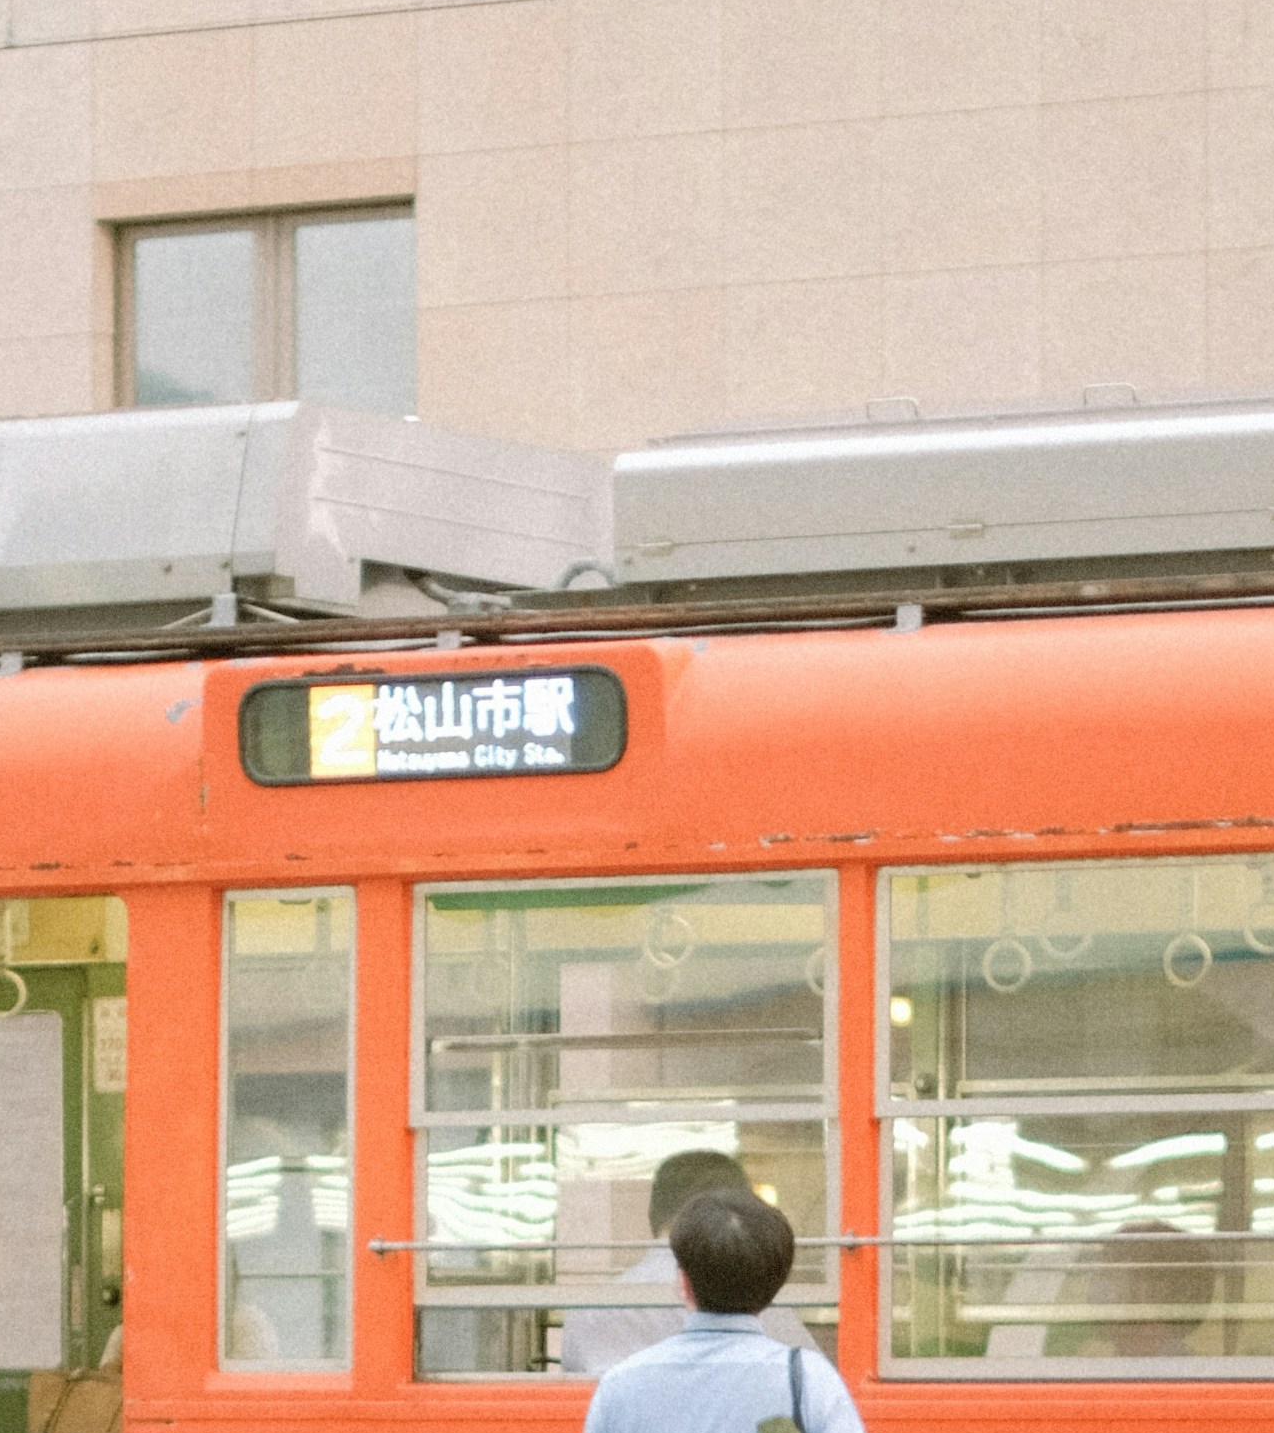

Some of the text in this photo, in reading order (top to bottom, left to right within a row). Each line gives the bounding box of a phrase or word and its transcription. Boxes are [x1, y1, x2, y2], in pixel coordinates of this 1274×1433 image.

[316, 692, 371, 765] 2
[373, 676, 576, 743] 松山市駅
[474, 744, 519, 770] City
